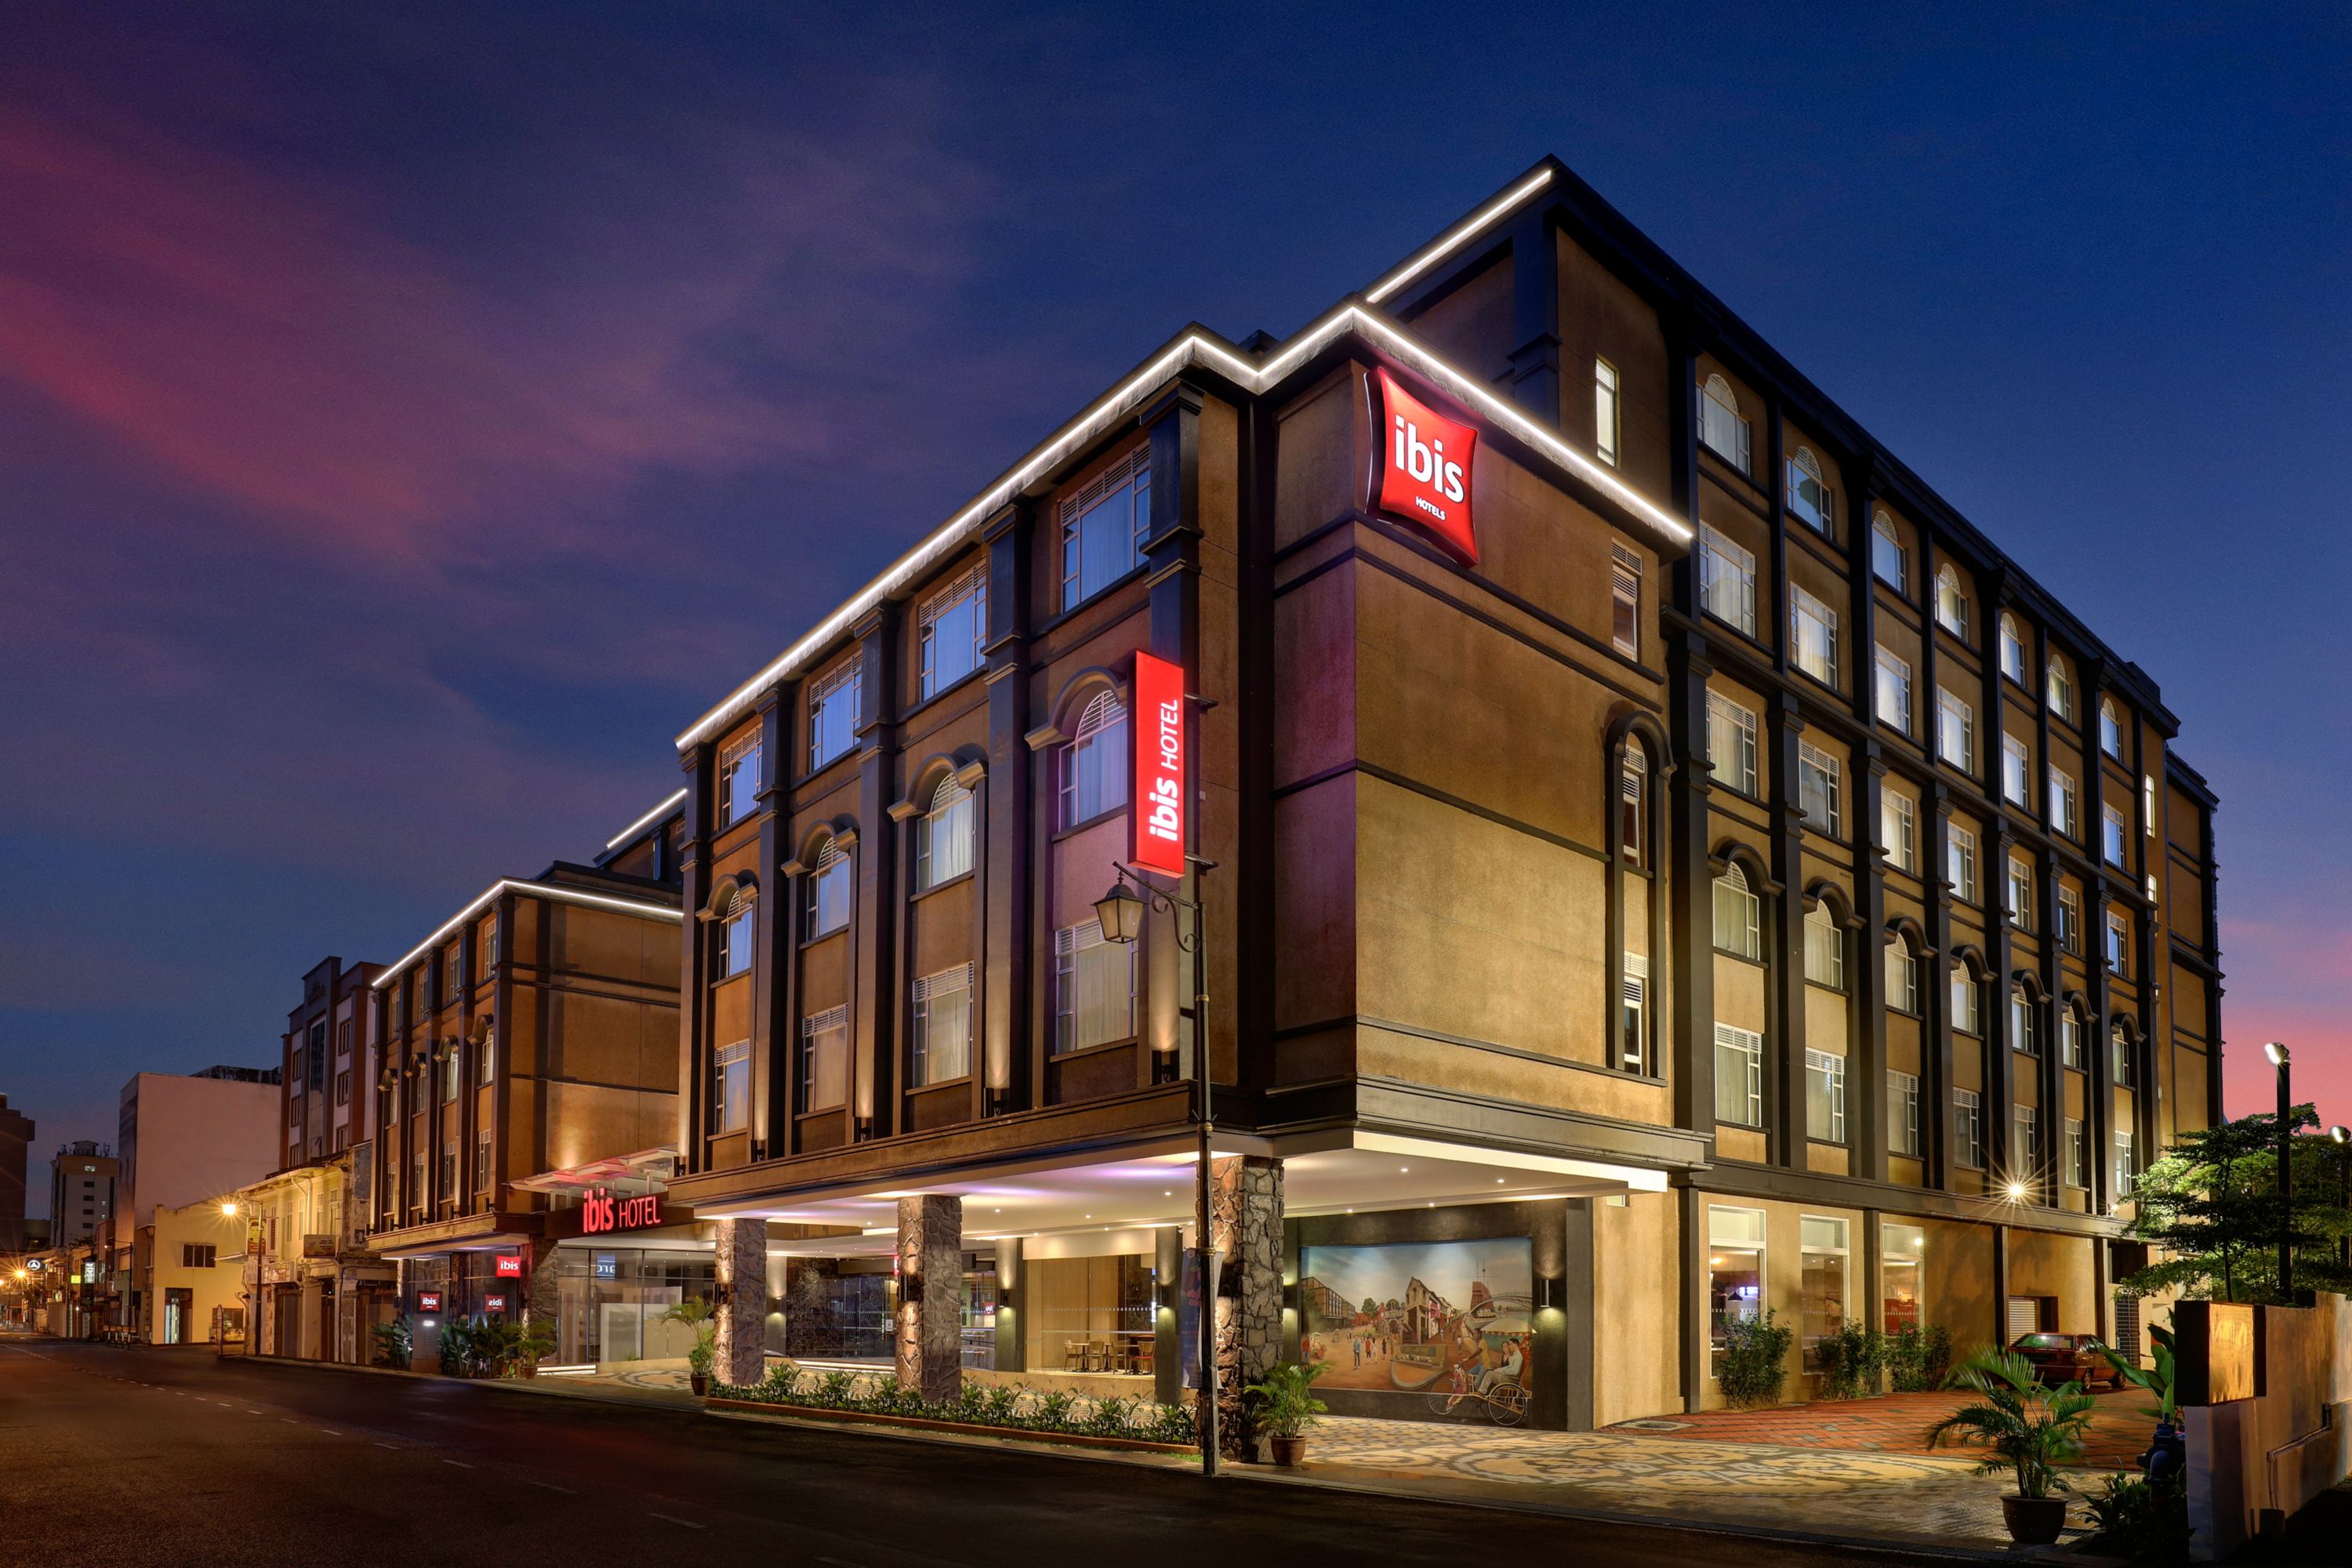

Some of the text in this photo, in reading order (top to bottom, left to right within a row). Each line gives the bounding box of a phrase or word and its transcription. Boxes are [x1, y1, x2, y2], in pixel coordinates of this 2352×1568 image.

[1396, 415, 1465, 503] ibis
[1415, 495, 1446, 521] HOTELS
[1149, 699, 1178, 842] ibis HOTEL
[583, 1187, 661, 1233] ibis HOTEL
[500, 1260, 519, 1270] ibis
[423, 1297, 437, 1305] ibis
